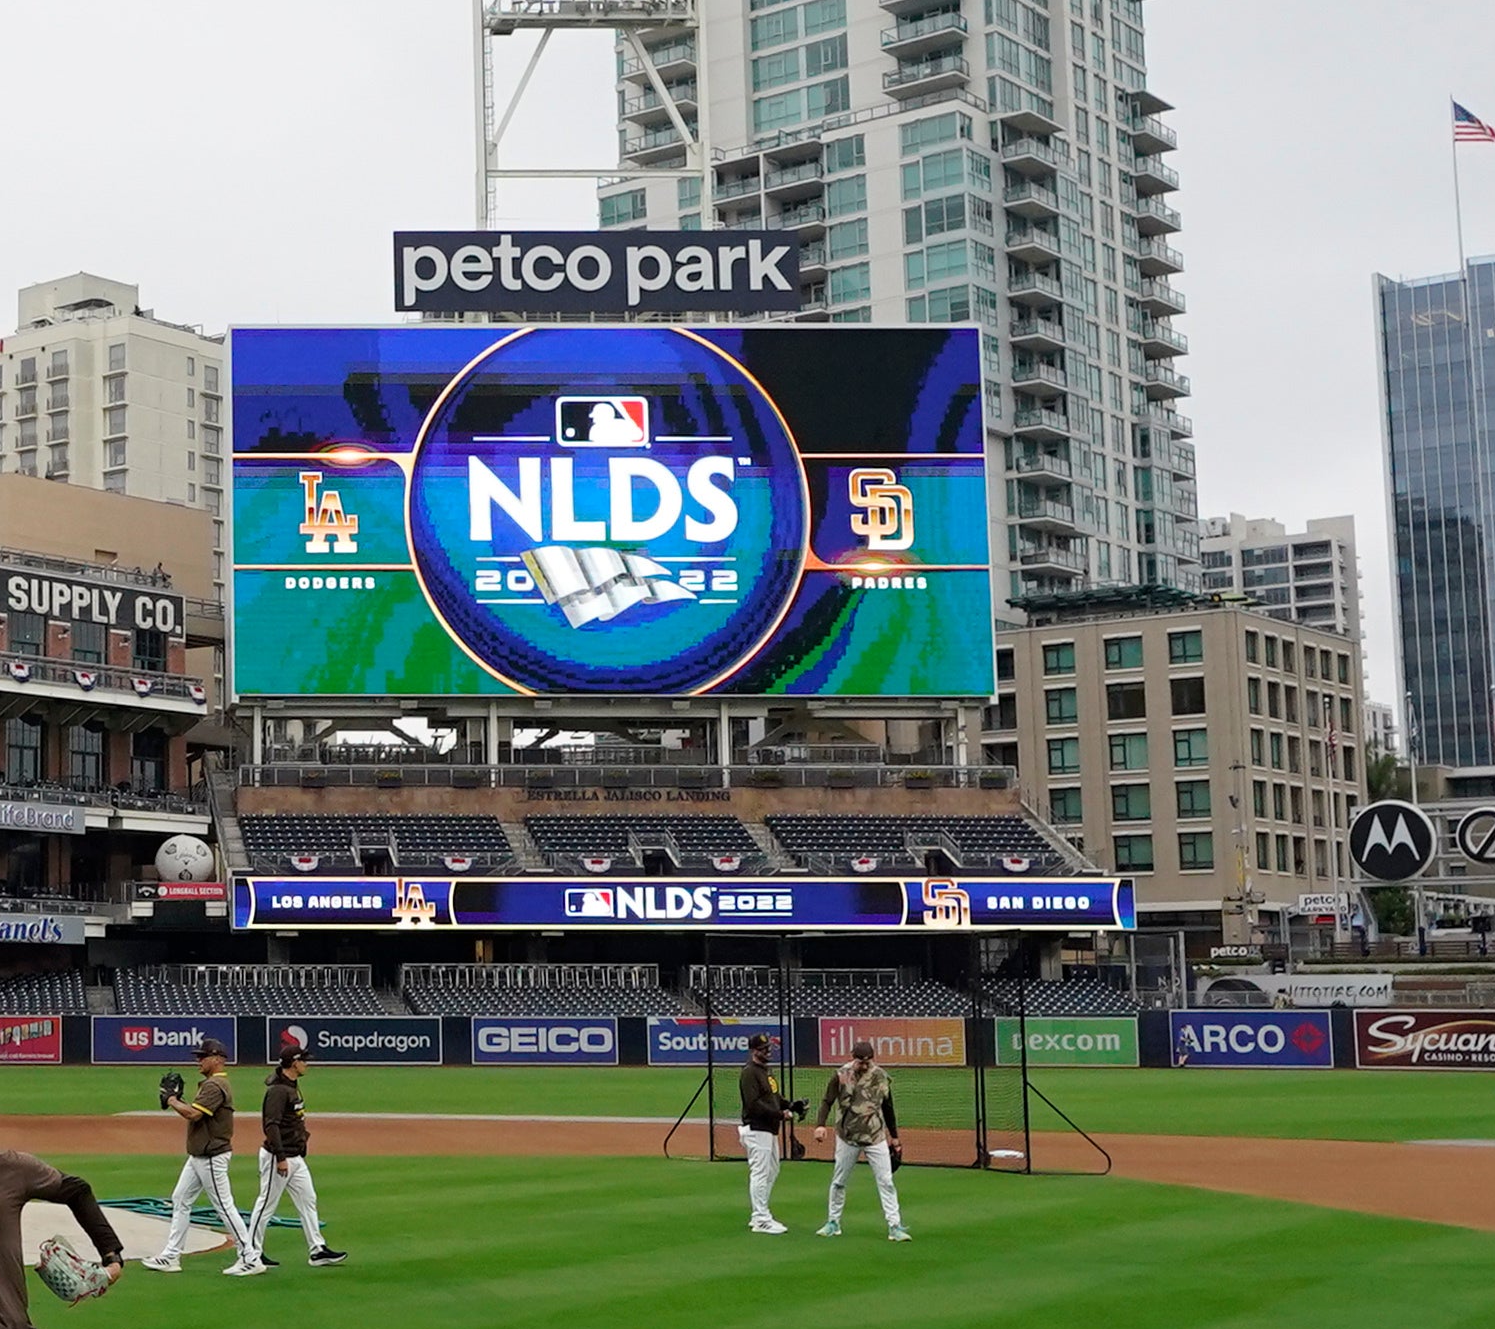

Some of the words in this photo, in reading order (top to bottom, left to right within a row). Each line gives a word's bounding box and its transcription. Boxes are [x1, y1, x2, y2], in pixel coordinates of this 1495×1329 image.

[402, 234, 612, 306] petco
[625, 238, 792, 306] park
[469, 455, 738, 543] NLDS
[285, 577, 376, 590] DODGERS
[476, 568, 535, 593] 20
[679, 568, 739, 593] 22
[851, 577, 928, 590] PADRES
[7, 575, 120, 625] SUPPLY
[134, 594, 182, 634] CO.
[527, 789, 600, 801] ESTRELLA
[604, 789, 662, 802] JALISCO
[667, 789, 731, 802] LANDING
[271, 895, 303, 909] LOS
[308, 895, 383, 910] ANGELES
[616, 886, 712, 919] NLDS
[718, 894, 793, 911] 2022
[987, 896, 1026, 910] SAN
[1032, 896, 1089, 910] DIEGO
[1301, 906, 1347, 914] BARKYAD
[1210, 946, 1248, 959] petco
[123, 1030, 149, 1046] us
[152, 1026, 205, 1047] bank
[317, 1029, 431, 1053] Snapdragon
[477, 1026, 614, 1053] GEICO
[658, 1031, 753, 1051] Southwe
[1179, 1023, 1285, 1054] ARCO
[1424, 1052, 1466, 1063] CASINO
